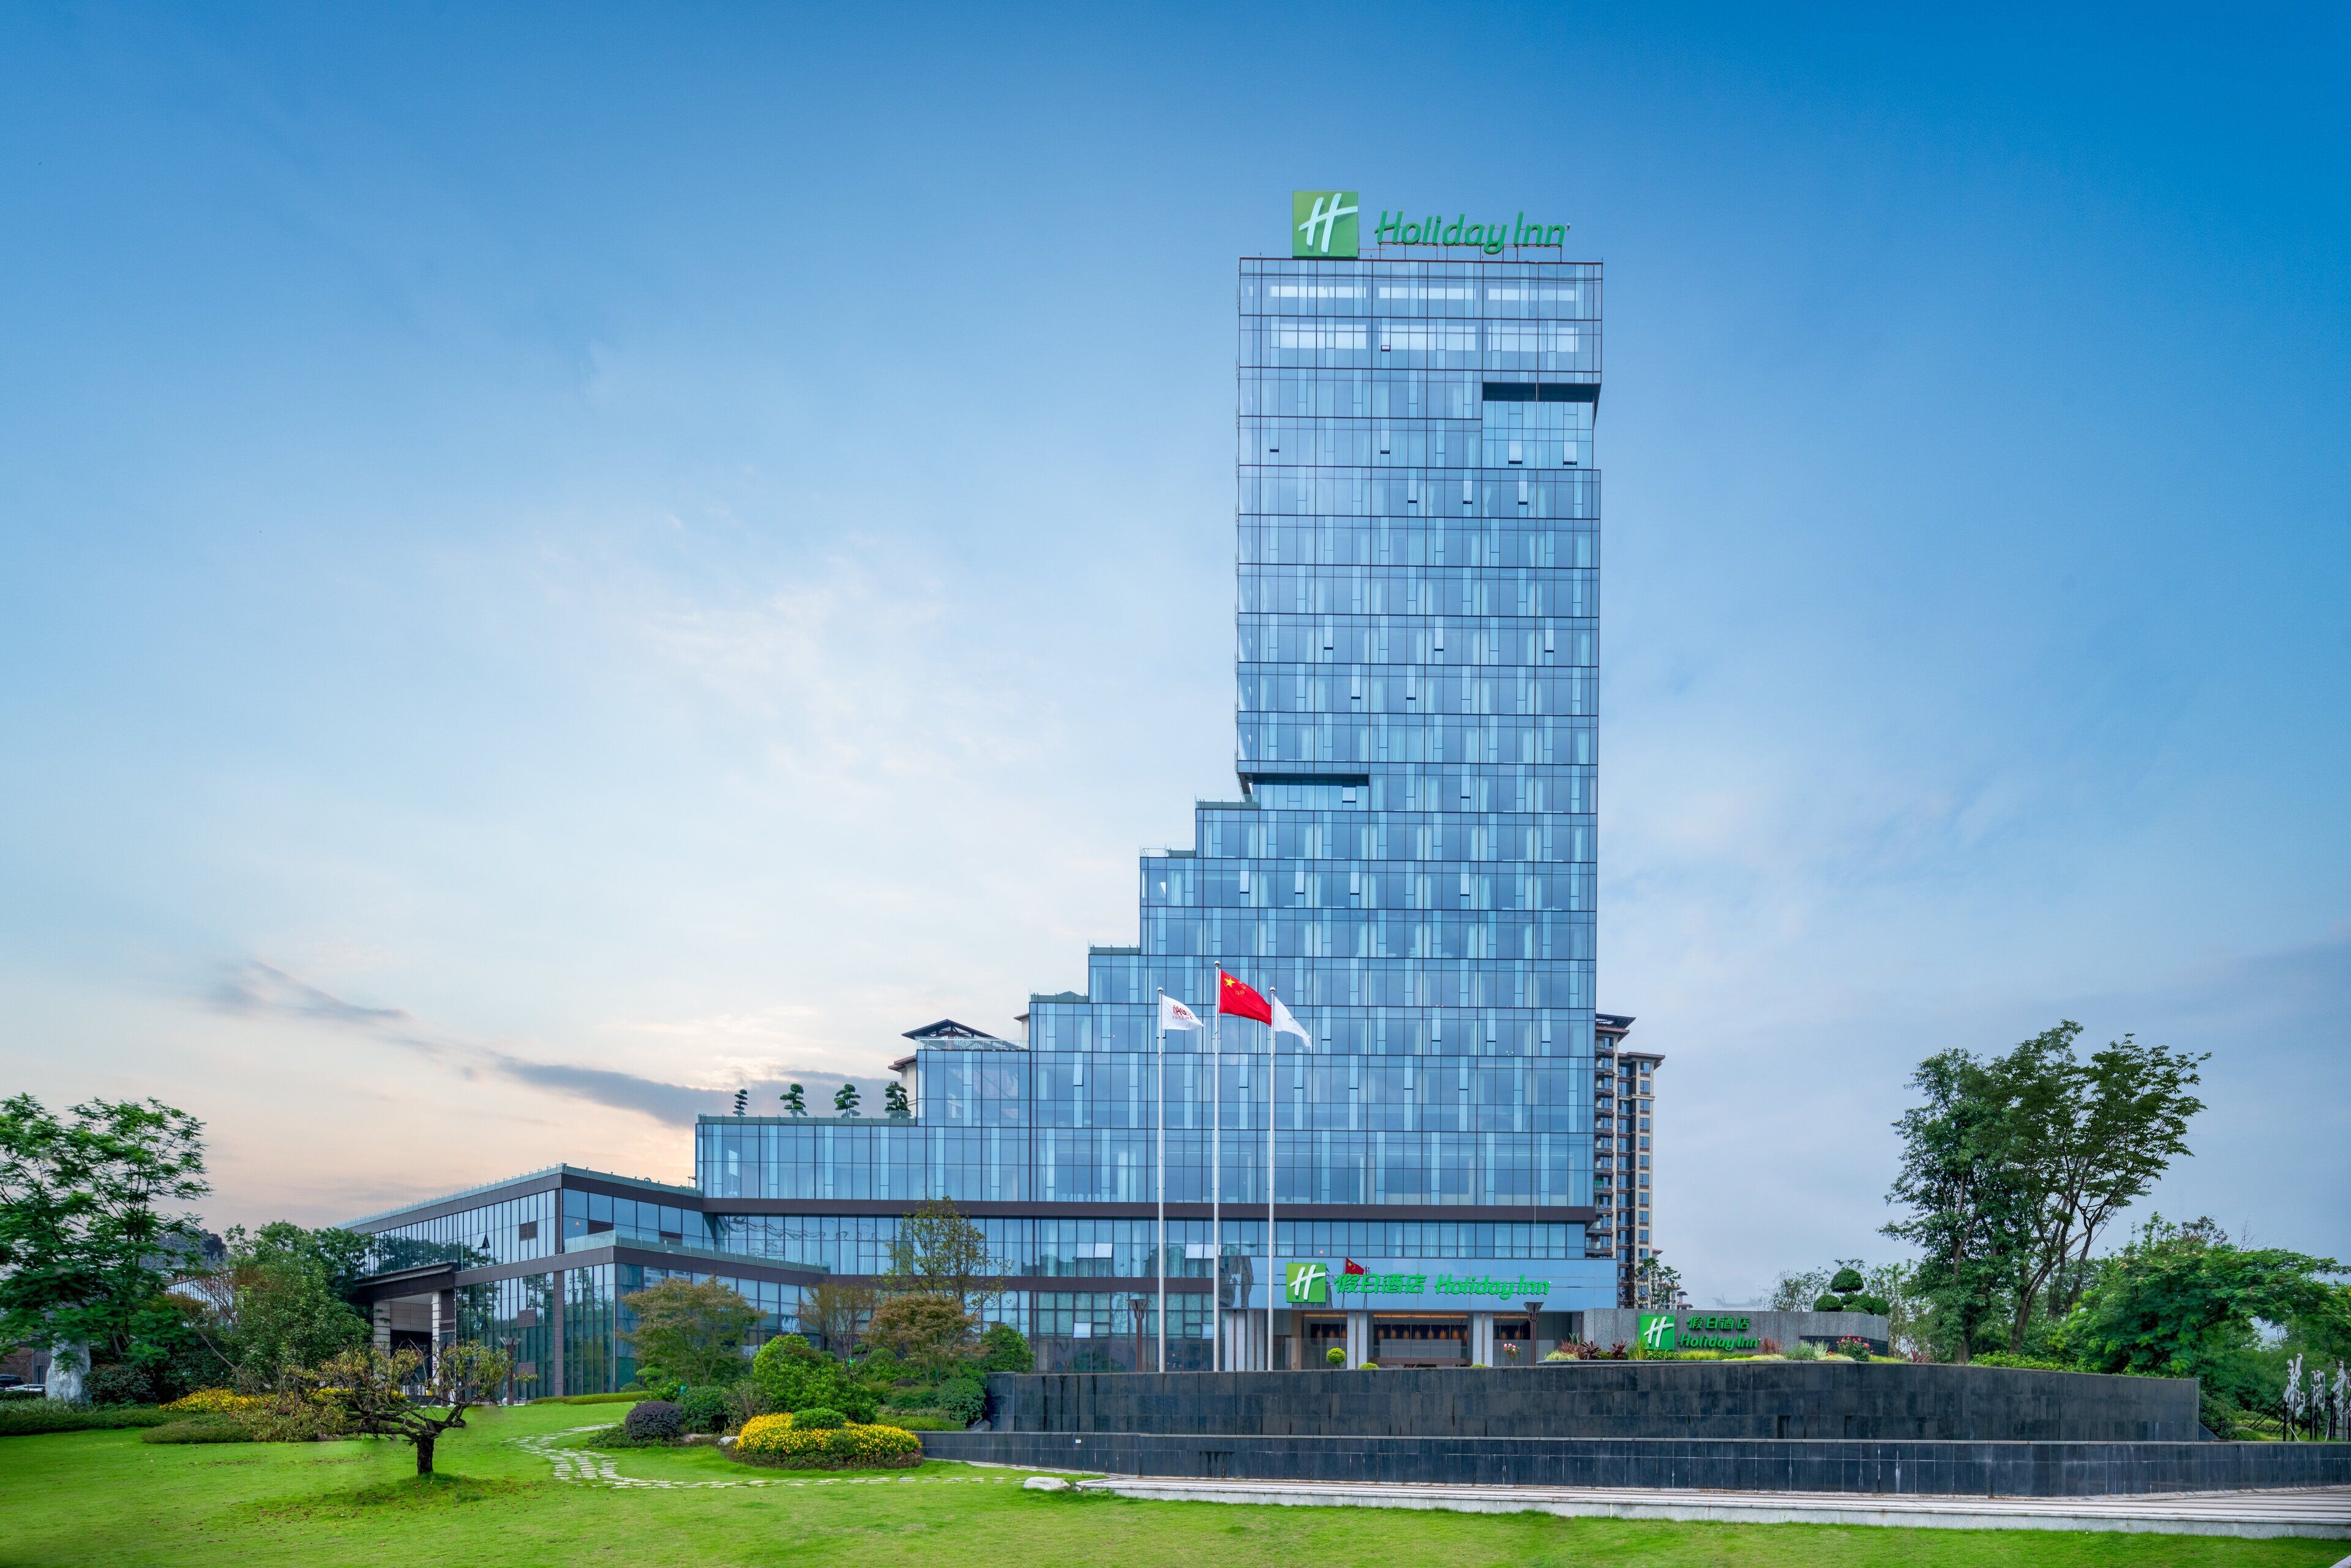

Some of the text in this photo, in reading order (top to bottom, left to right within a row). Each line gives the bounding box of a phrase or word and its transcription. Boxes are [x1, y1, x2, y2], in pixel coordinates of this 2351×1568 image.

[1374, 210, 1565, 255] Holiday Inn
[1333, 1274, 1550, 1300] 假日酒店 Holiday Inn
[1687, 1316, 1750, 1330] 假日酒店
[1679, 1334, 1758, 1351] Holiday Inn
